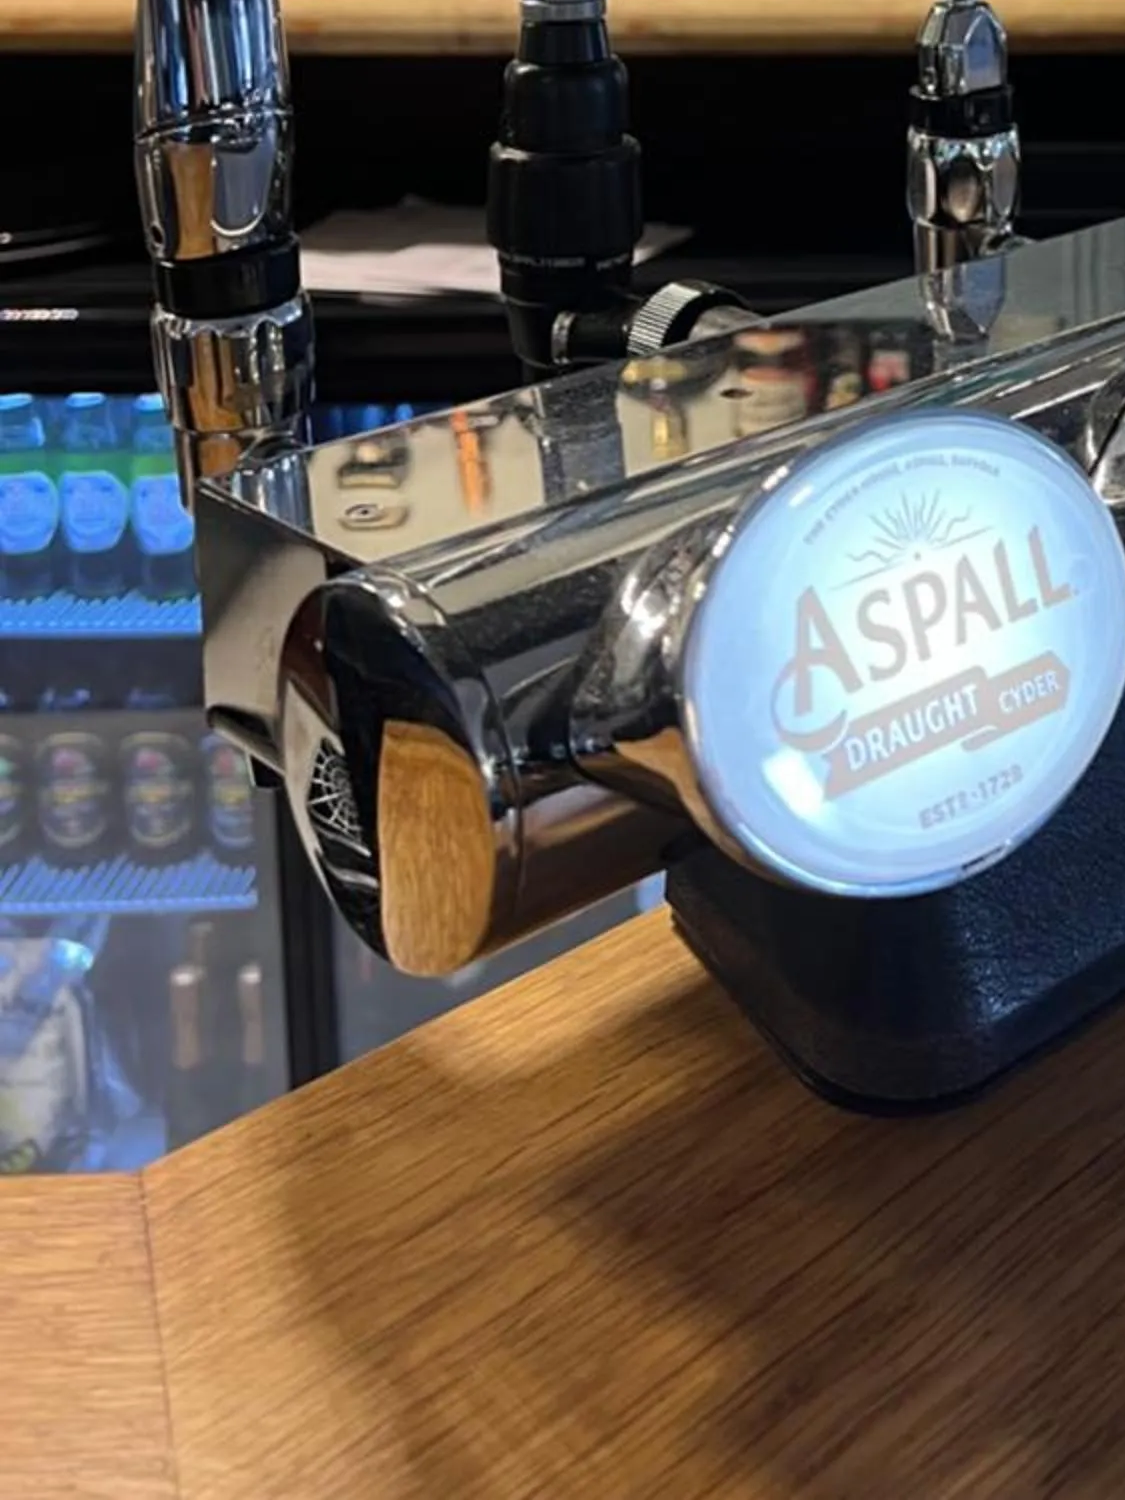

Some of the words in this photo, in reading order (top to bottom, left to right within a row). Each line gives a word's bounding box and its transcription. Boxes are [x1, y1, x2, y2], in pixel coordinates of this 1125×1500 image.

[771, 523, 1072, 752] ASPALL
[845, 684, 980, 771] DRAUGHT
[997, 669, 1062, 715] CYDER
